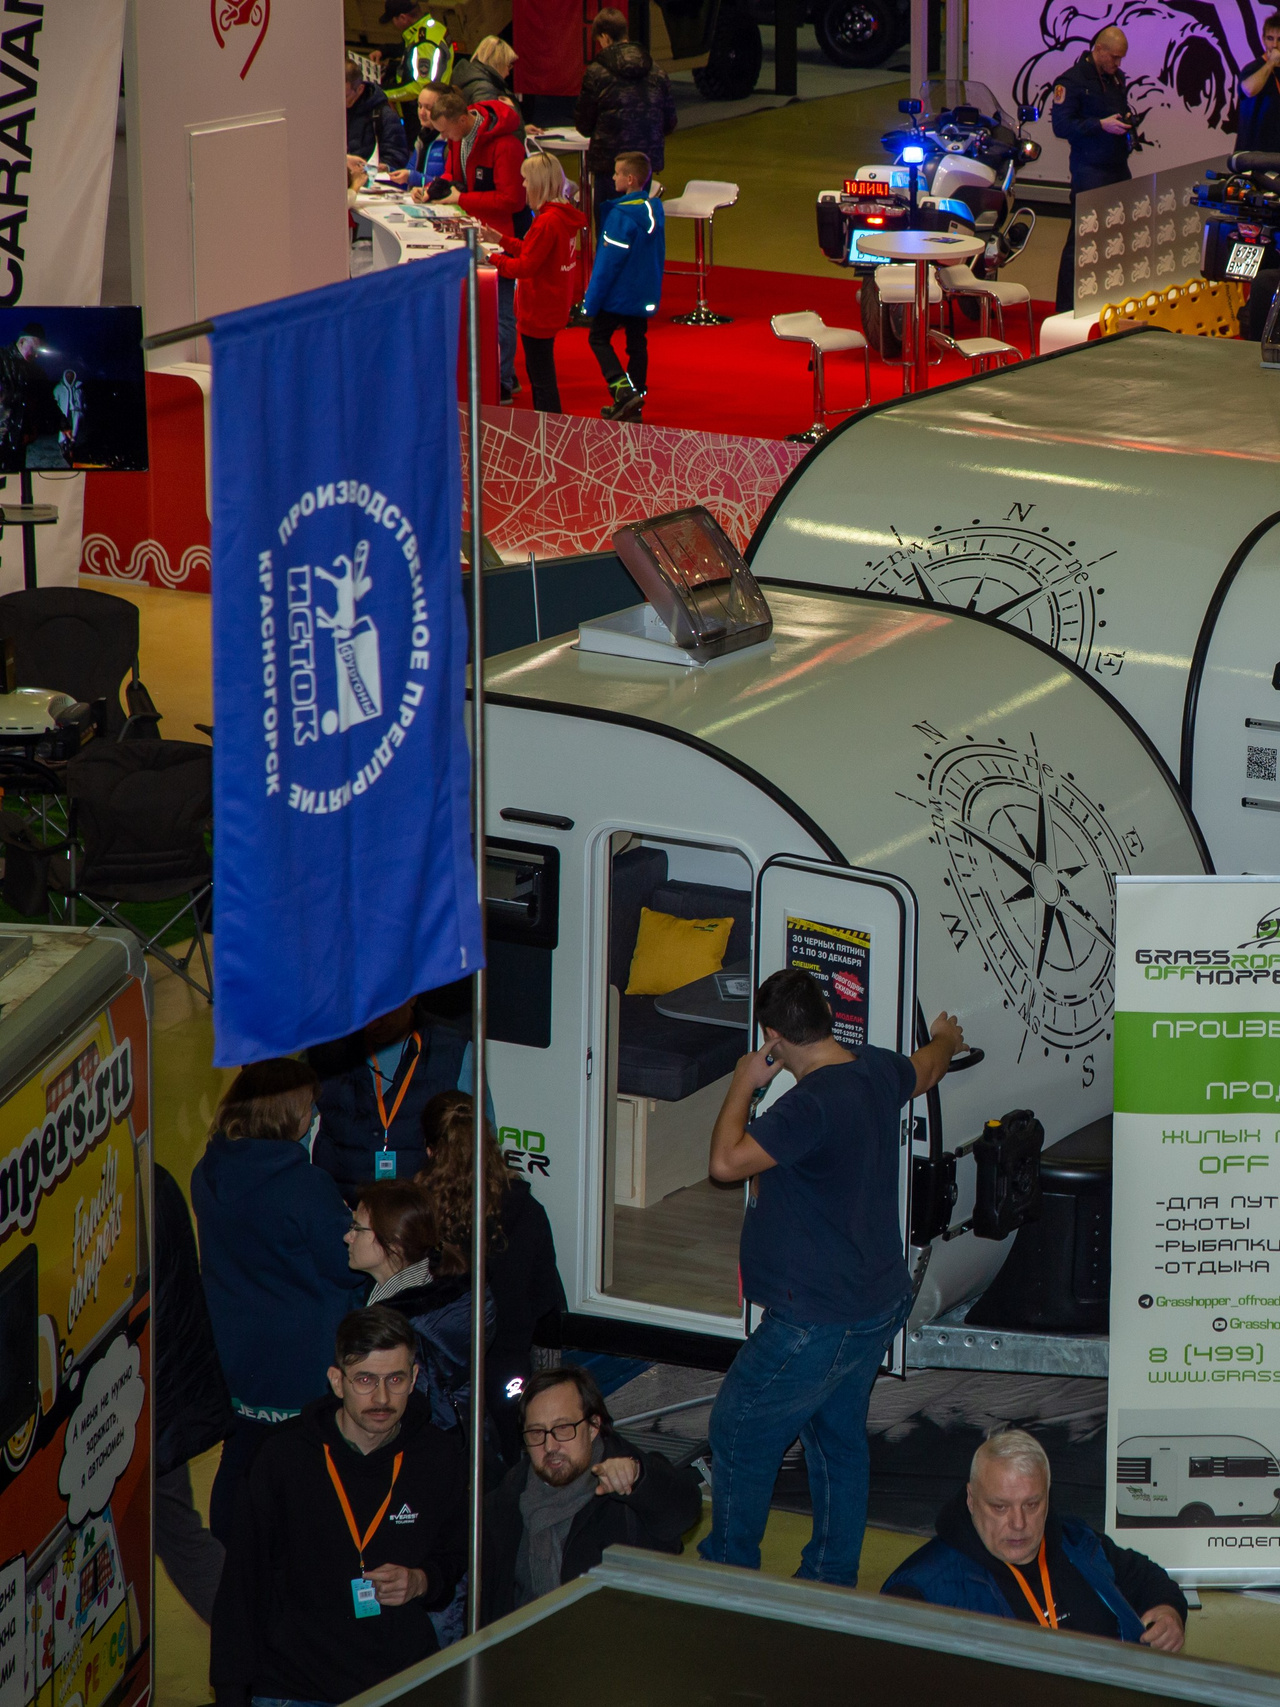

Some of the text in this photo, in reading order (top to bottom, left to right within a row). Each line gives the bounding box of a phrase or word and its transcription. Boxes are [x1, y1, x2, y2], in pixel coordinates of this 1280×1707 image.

[0, 0, 44, 306] CARAVA
[1002, 502, 1036, 522] N
[277, 480, 431, 815] ПРОИЗВОДСТВЕННОЕ ПРЕДПРИЯТИЕ
[286, 564, 320, 747] ИСТОК
[258, 549, 281, 798] КРАСНОГОРСК
[911, 720, 948, 744] N
[940, 911, 969, 953] W
[792, 934, 866, 958] 30 ЧЕРНЫХ ПЯТНИЦ
[799, 946, 805, 954] 1
[805, 948, 816, 956] ПО
[817, 950, 827, 959] 30
[828, 952, 862, 967] ДЕКАБРЯ
[1135, 949, 1230, 965] GRASS
[831, 971, 865, 994] НОВОГОДНИЕ
[1144, 965, 1196, 981] OFF
[1083, 1055, 1095, 1089] S
[1161, 1129, 1262, 1144] ЖИЛЫХ
[1199, 1155, 1270, 1175] OFF
[1148, 1346, 1168, 1363] 8
[1184, 1343, 1264, 1366] (499)
[72, 1364, 133, 1444] А меня не нужно
[87, 1426, 125, 1480] автономен
